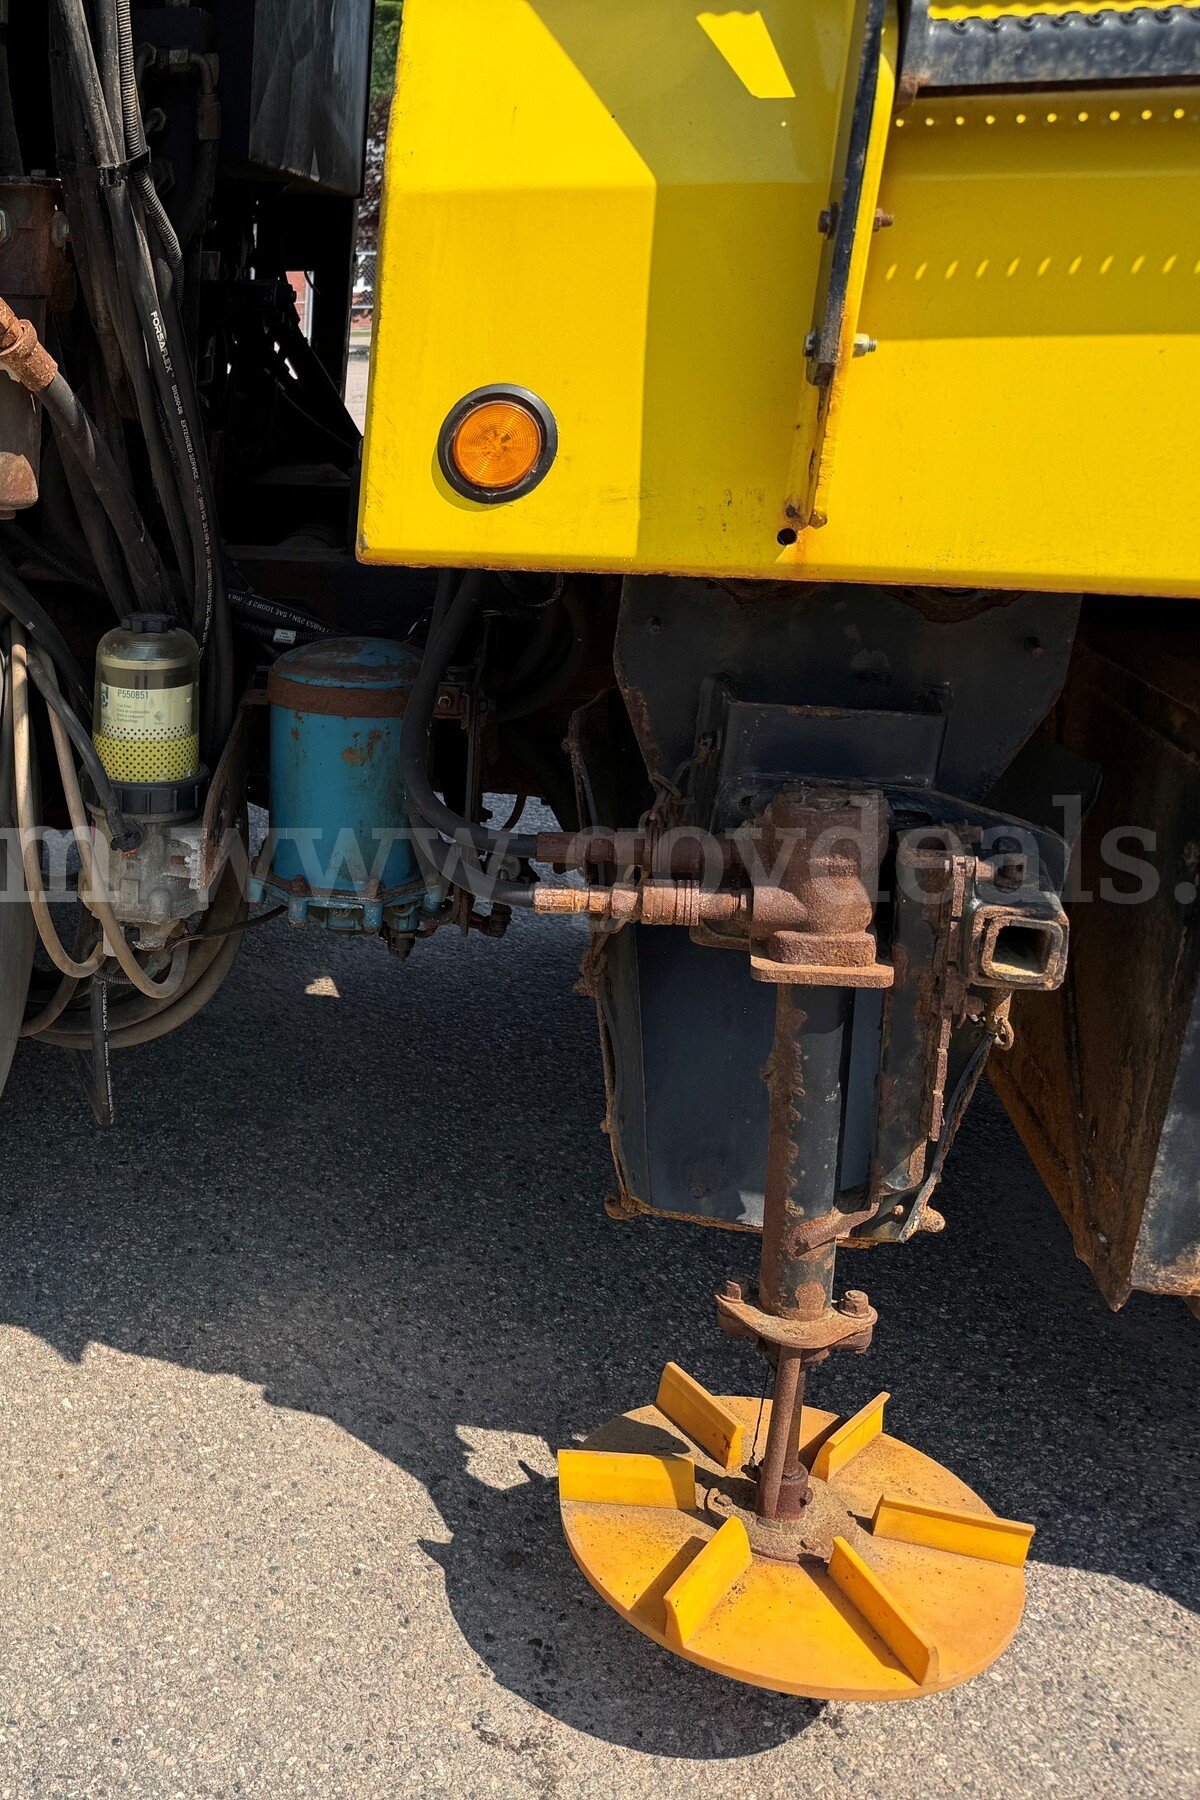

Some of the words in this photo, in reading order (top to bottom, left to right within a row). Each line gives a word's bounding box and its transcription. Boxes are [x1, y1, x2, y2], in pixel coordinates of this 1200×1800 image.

[150, 310, 173, 374] FORSAFLEX
[180, 419, 194, 454] EXTENDED
[117, 690, 149, 700] P550851
